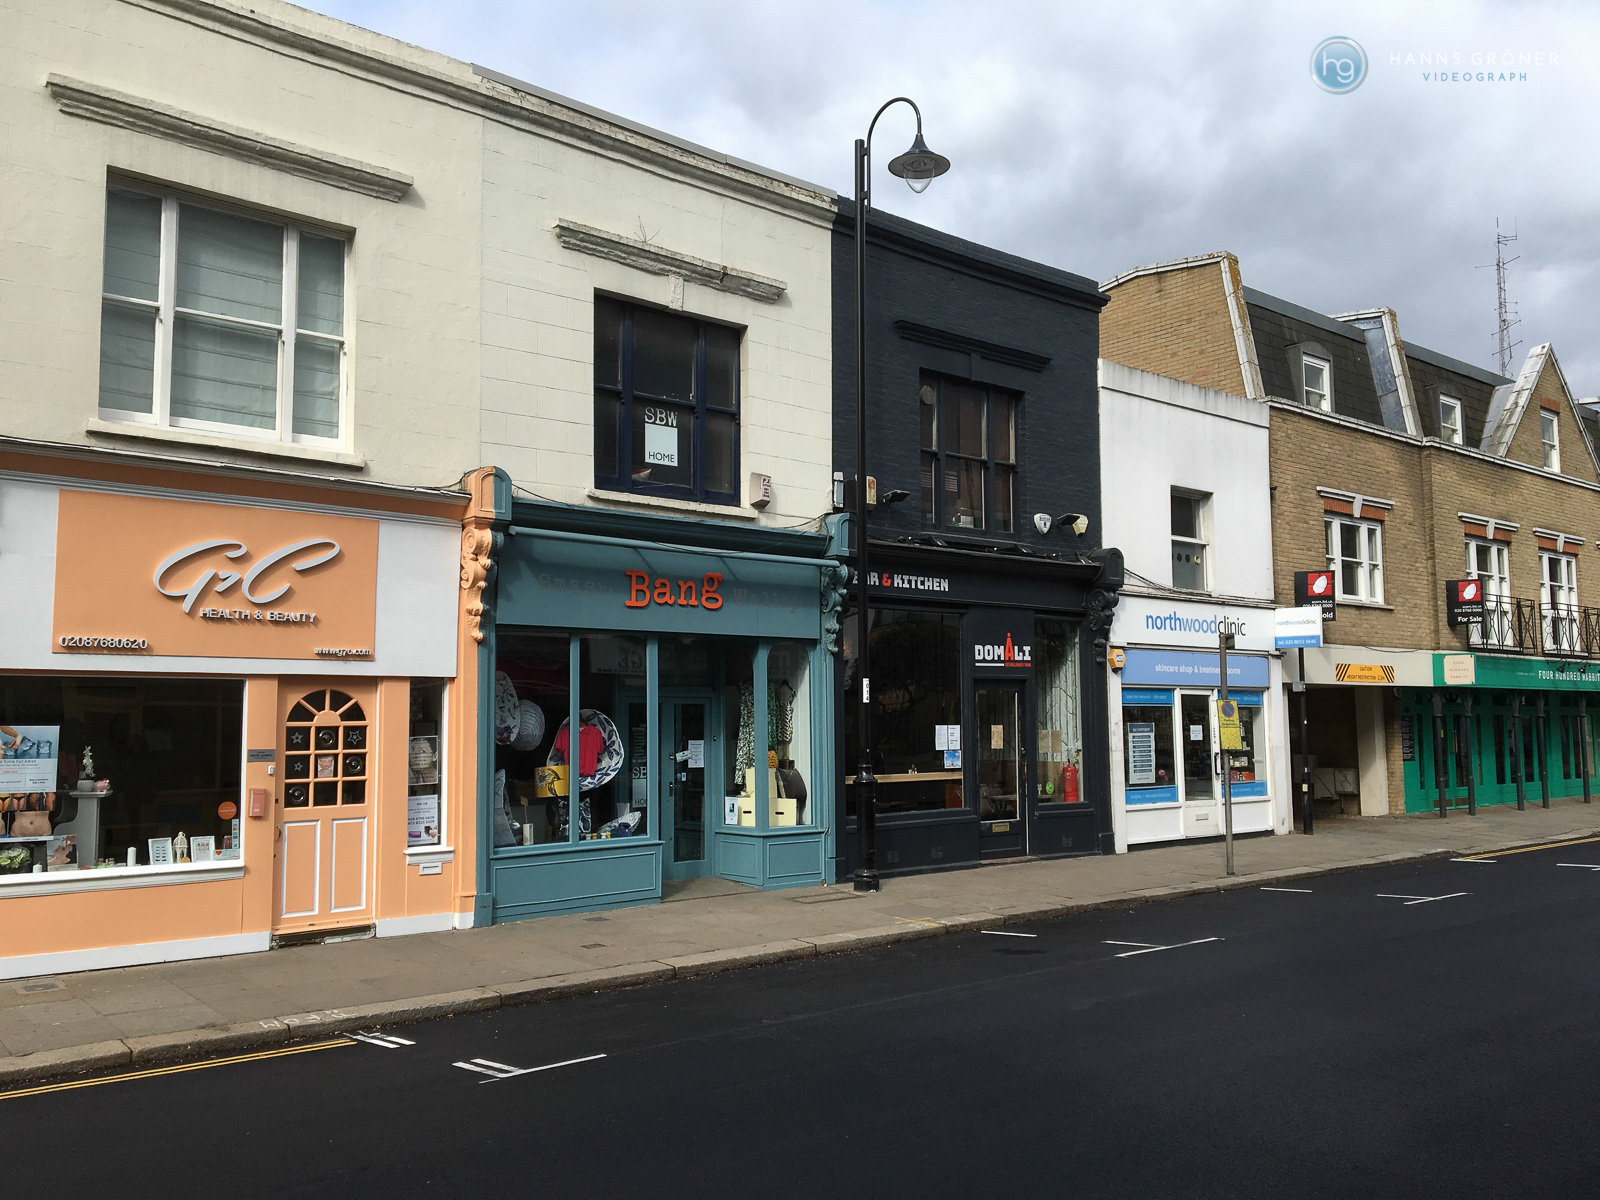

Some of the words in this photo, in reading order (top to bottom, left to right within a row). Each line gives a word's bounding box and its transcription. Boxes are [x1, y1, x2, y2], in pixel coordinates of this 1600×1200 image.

[644, 406, 678, 427] SBW
[648, 451, 675, 463] HOME
[624, 569, 723, 610] Bang
[881, 573, 892, 587] &
[893, 574, 950, 592] KITCHEN
[200, 607, 250, 621] HEALTH
[253, 609, 264, 621] &
[267, 610, 317, 624] BEAUTY
[1145, 611, 1247, 637] northwoodclinic
[59, 636, 149, 650] 02087680620
[1154, 663, 1179, 673] skincare
[1179, 664, 1193, 675] shop
[1193, 665, 1199, 674] &
[1538, 670, 1554, 680] FOUR
[1555, 671, 1581, 681] HUNDRED
